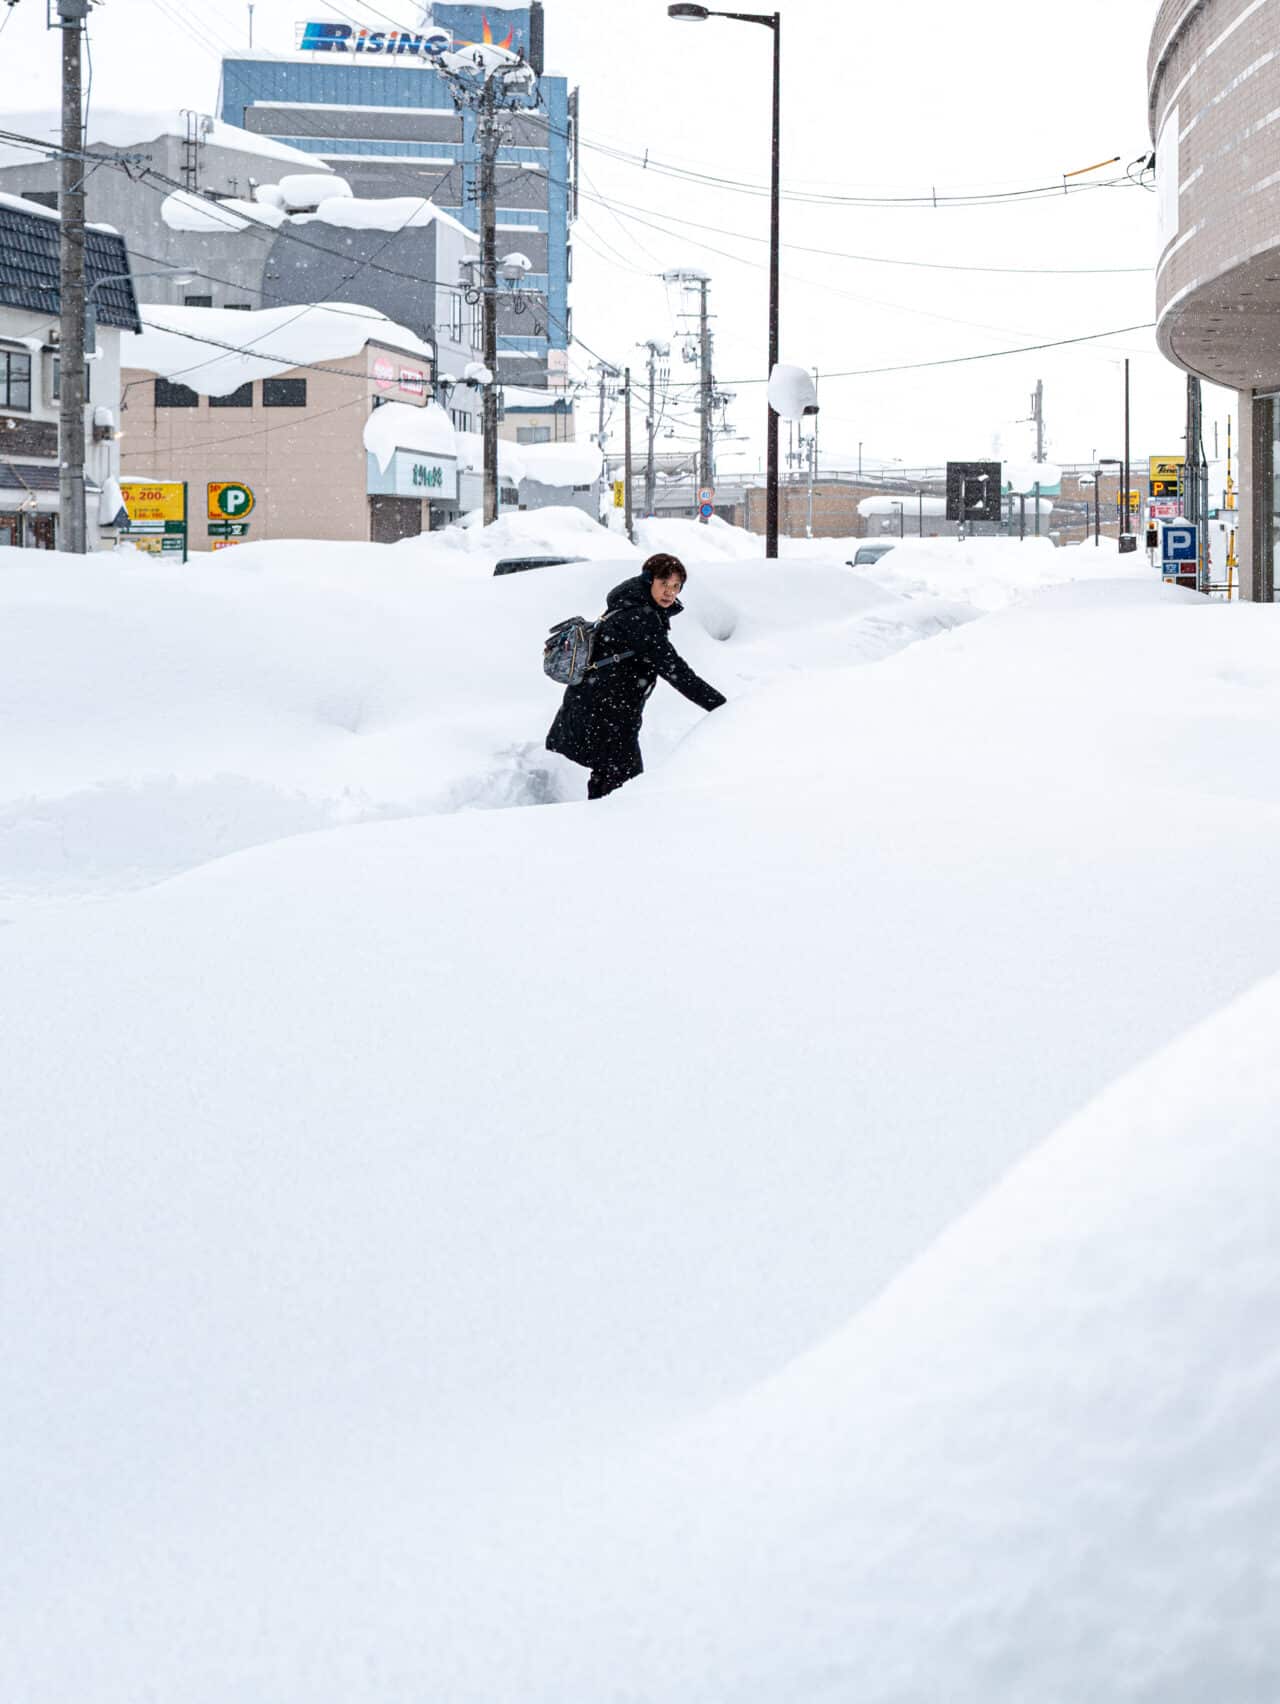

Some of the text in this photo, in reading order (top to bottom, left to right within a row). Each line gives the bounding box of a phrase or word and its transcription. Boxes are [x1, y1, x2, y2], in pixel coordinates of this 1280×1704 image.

[1153, 482, 1164, 496] P
[227, 490, 245, 513] P
[1167, 530, 1192, 556] P
